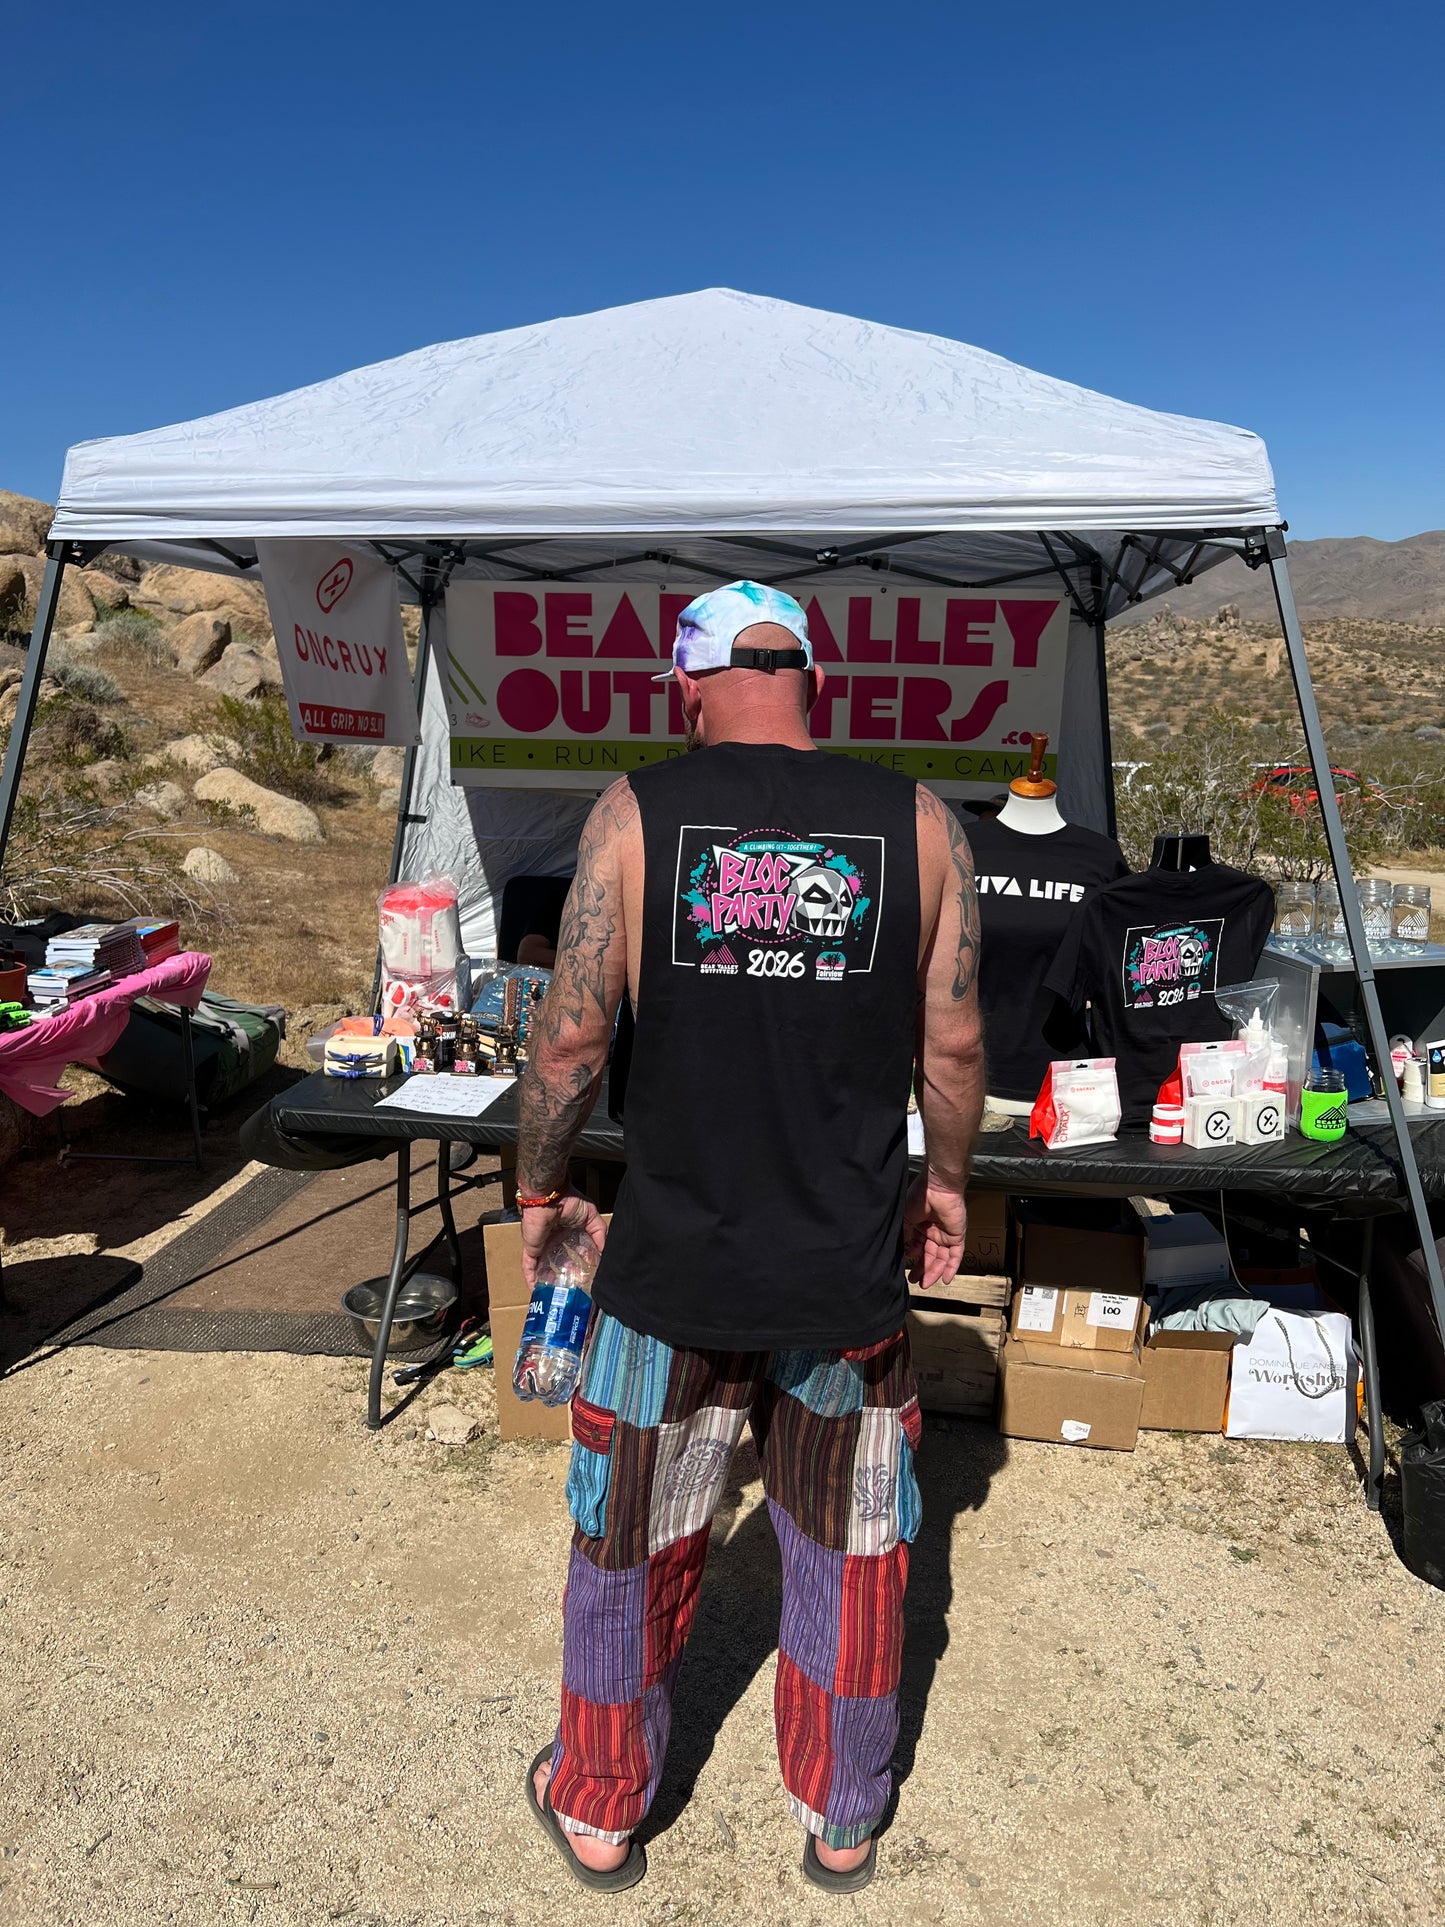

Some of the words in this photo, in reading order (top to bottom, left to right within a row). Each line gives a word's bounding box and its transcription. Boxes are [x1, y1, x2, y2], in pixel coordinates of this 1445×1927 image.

[797, 595, 1060, 667] ALLEY
[294, 623, 388, 676] ONCRUX
[303, 709, 326, 728] ALL
[330, 711, 355, 732] GRIP,
[358, 715, 369, 731] NO
[497, 668, 1009, 742] OUTTERS
[1001, 731, 1034, 745] .CO
[458, 744, 506, 763] IKE
[555, 745, 618, 765] RUN
[720, 852, 791, 894] BLOC
[1029, 878, 1085, 903] LIFE
[711, 891, 796, 935] PARTY
[746, 948, 806, 979] 2026
[1157, 986, 1185, 1006] 2026
[1060, 1110, 1071, 1143] CHALK
[1103, 1306, 1121, 1316] 100
[1249, 1369, 1346, 1393] Workshop
